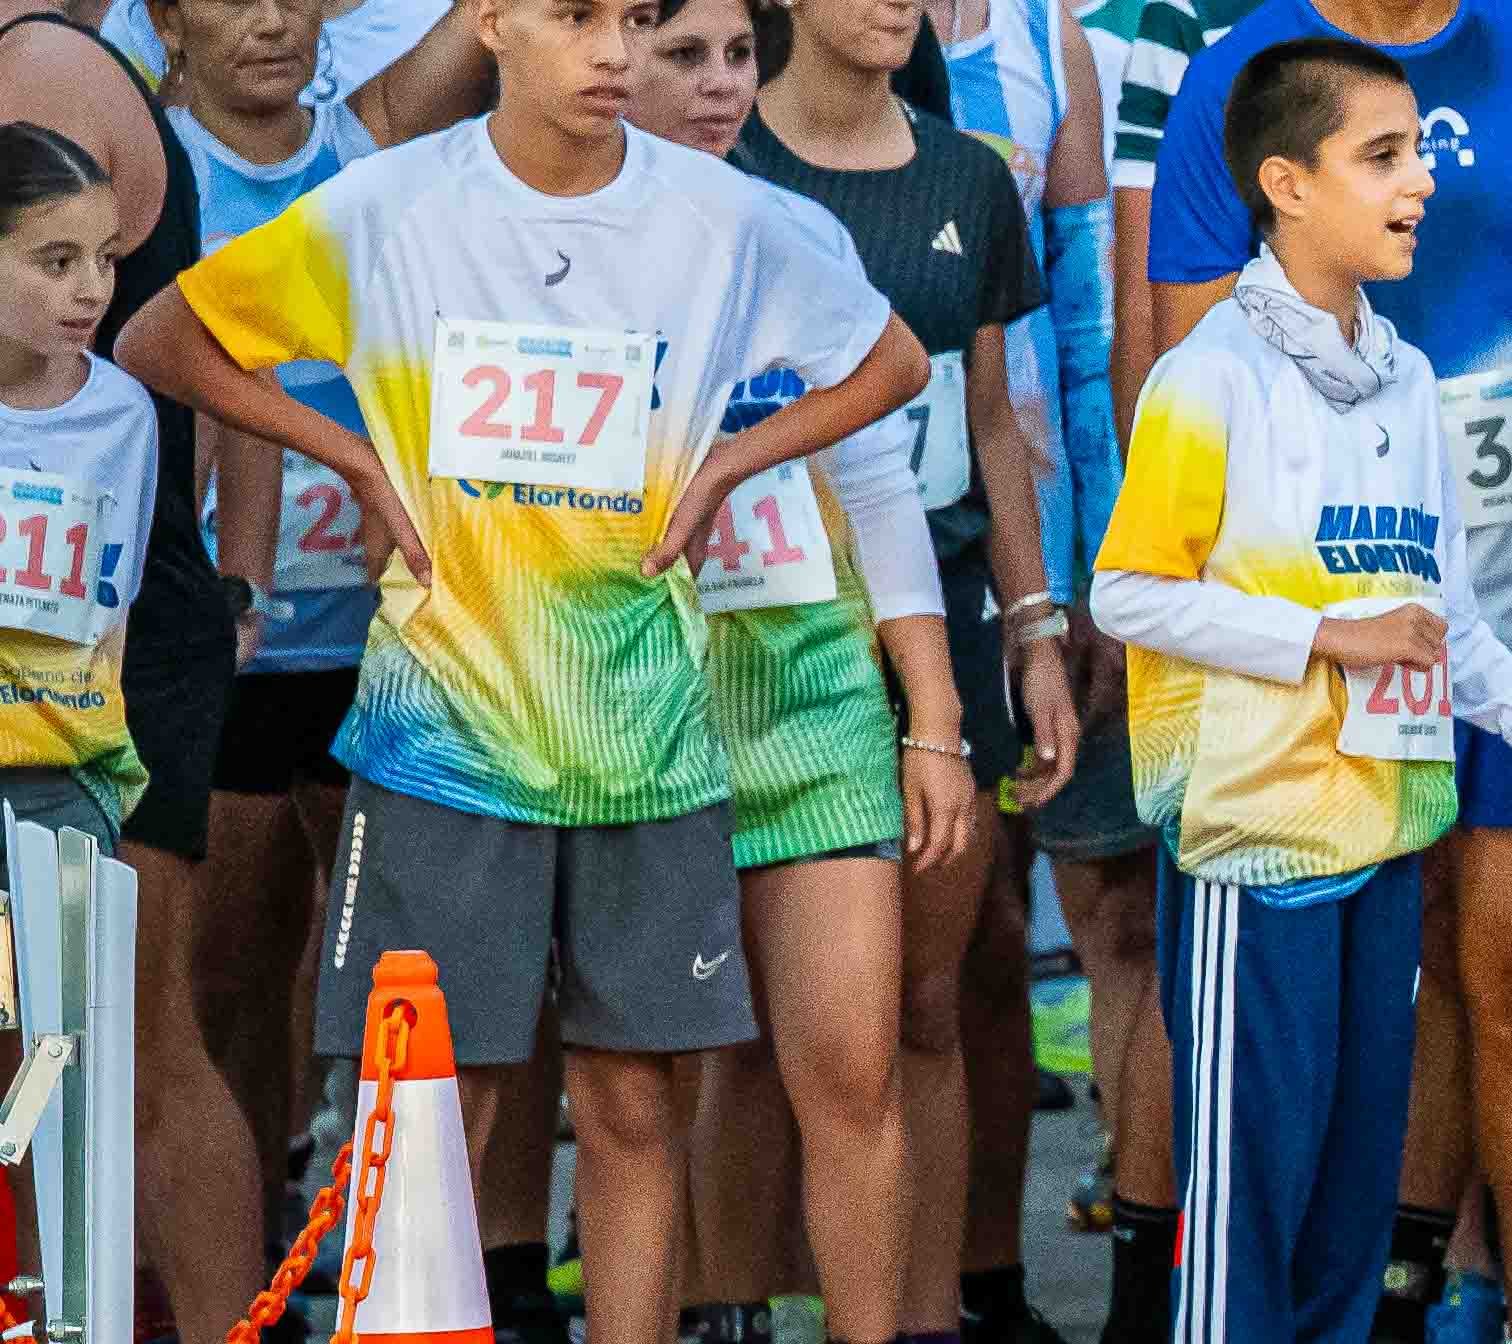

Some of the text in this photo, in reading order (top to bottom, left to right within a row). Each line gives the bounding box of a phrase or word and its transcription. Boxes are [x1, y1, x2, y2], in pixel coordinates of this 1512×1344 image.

[458, 364, 625, 446] 217
[512, 481, 643, 514] Elortondo
[0, 512, 89, 600] 11
